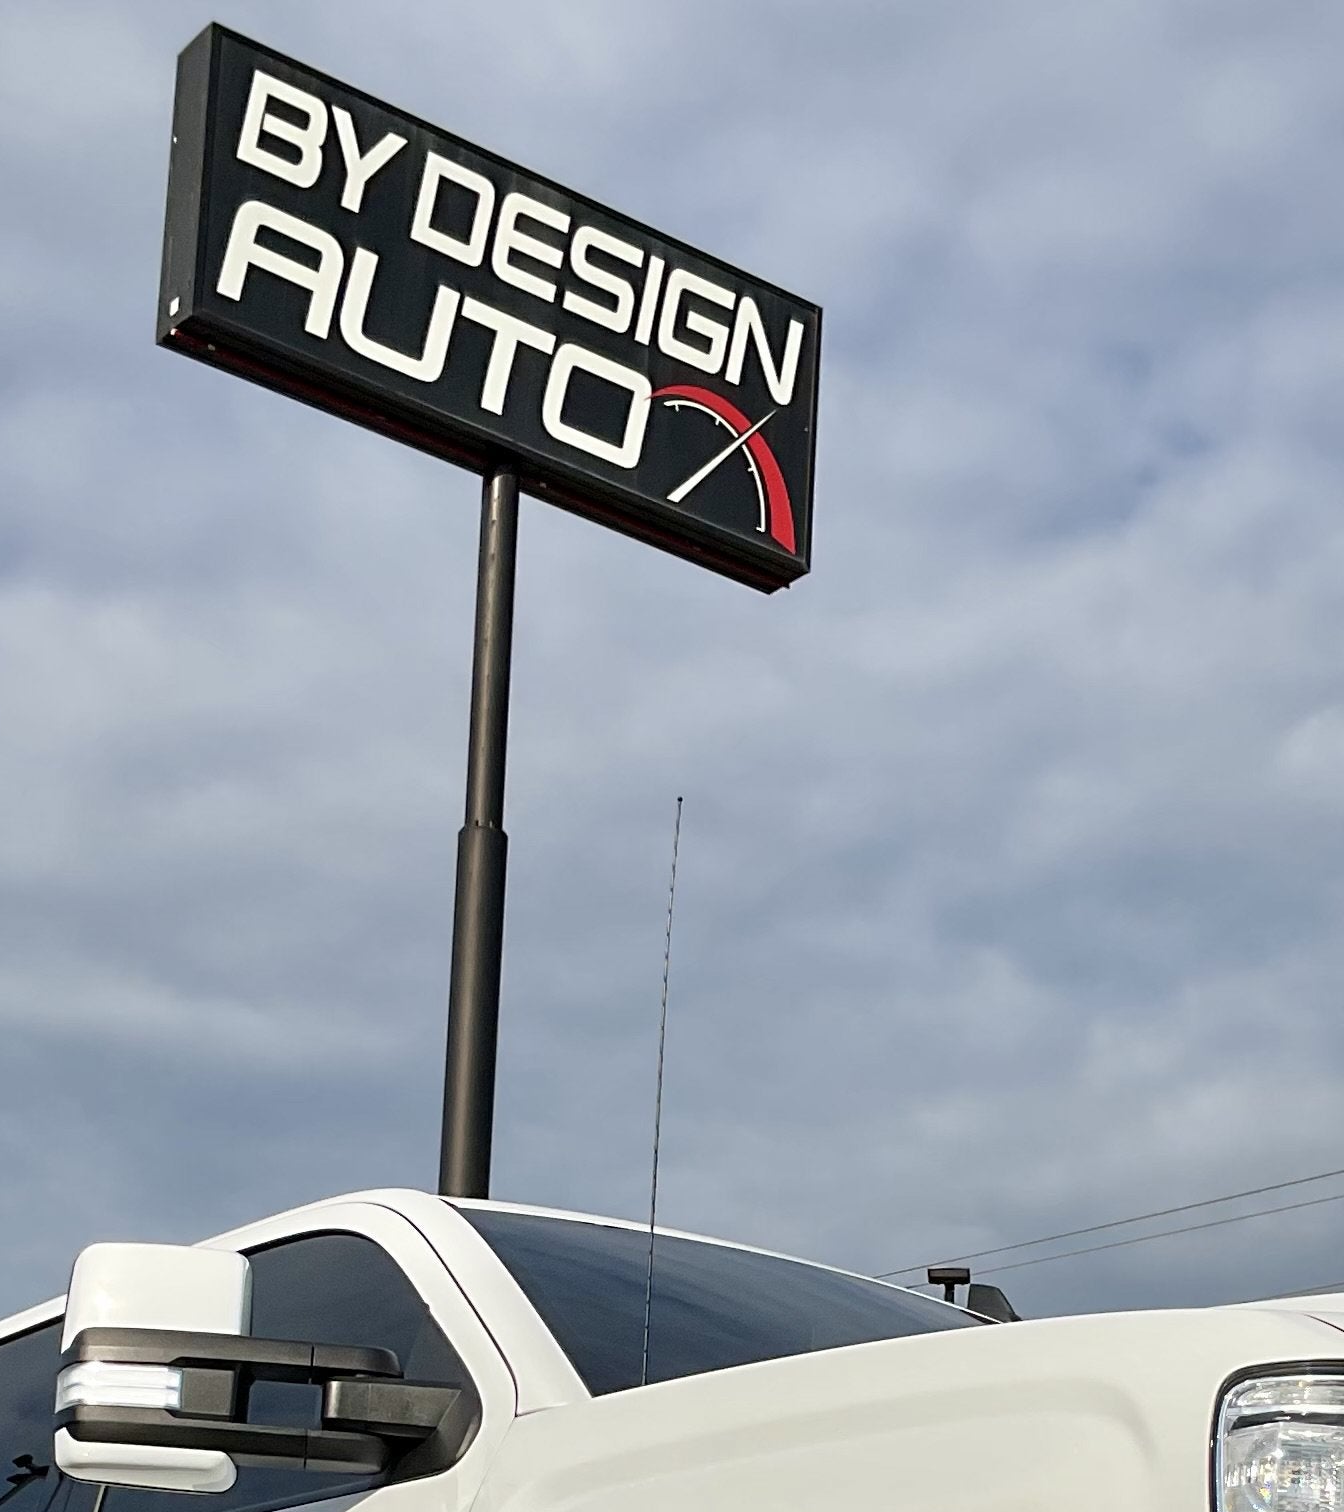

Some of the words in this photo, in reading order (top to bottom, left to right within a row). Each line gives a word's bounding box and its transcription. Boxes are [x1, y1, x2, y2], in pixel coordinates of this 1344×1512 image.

[216, 200, 652, 469] AUTO
[236, 69, 408, 214] BY
[410, 151, 804, 405] DESIGN
